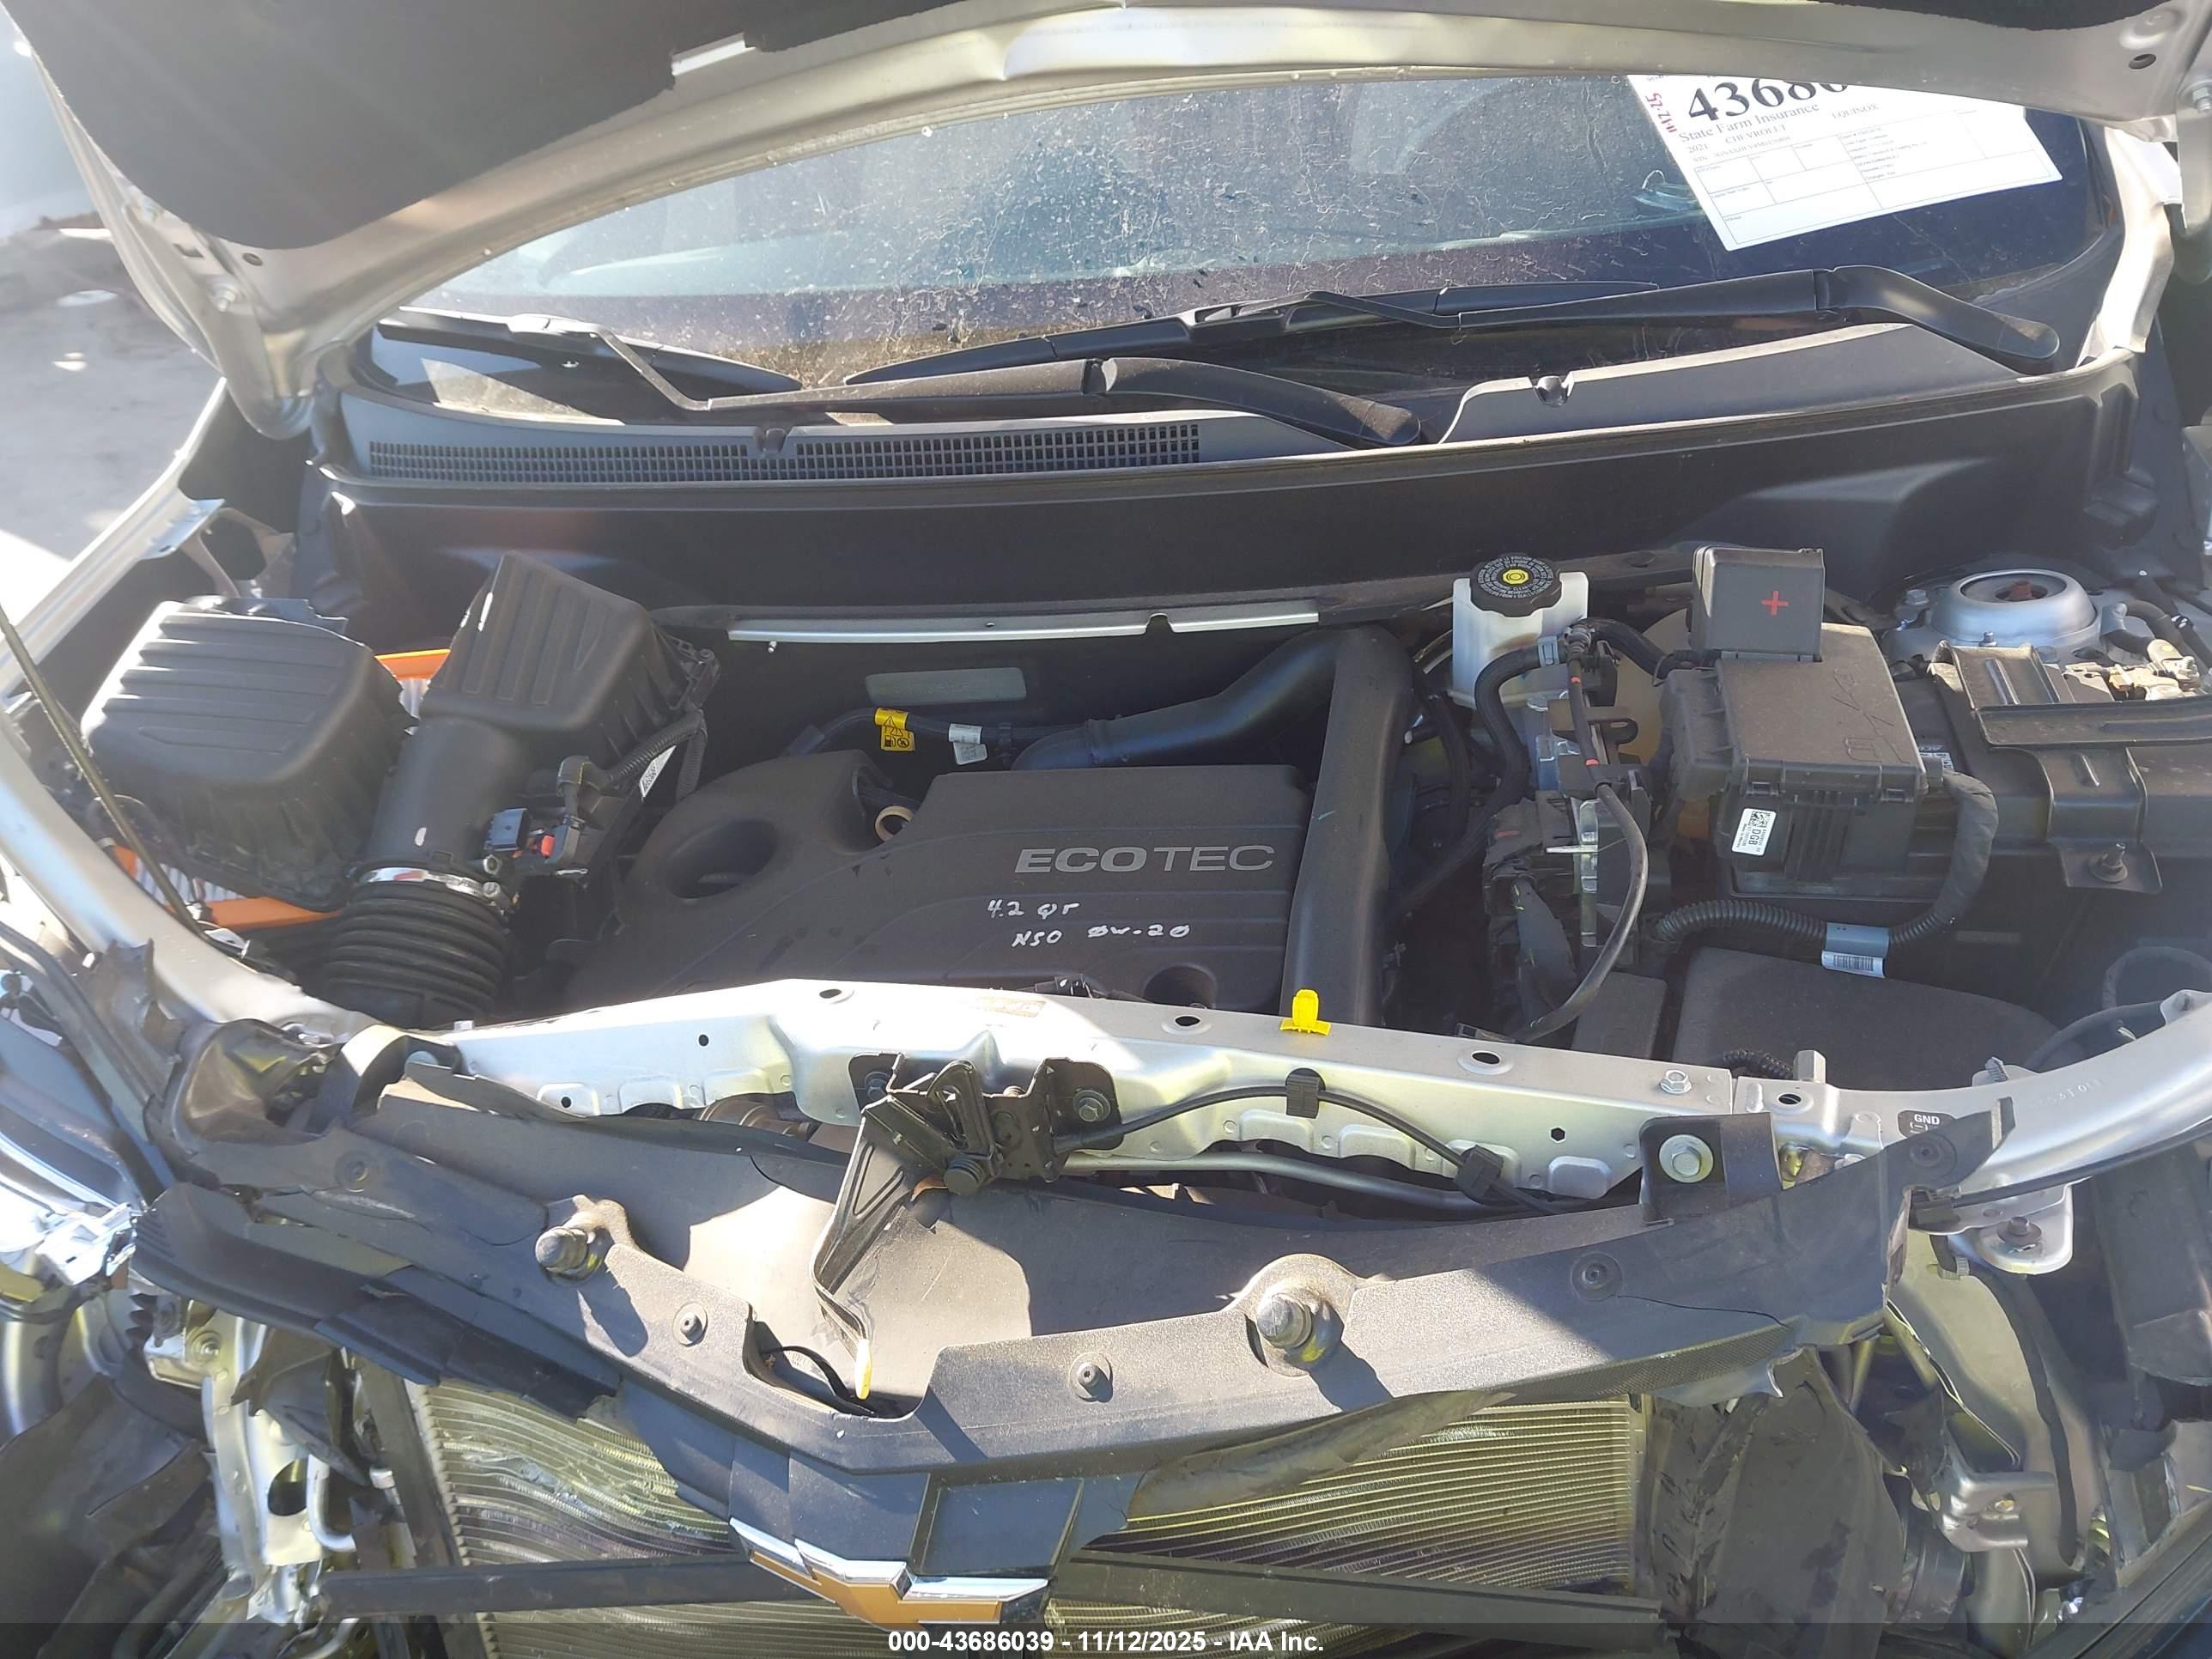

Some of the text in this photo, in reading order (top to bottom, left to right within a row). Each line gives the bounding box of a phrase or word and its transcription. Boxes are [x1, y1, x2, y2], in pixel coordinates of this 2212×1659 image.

[1688, 78, 1848, 120] 4368
[1679, 103, 1820, 143] State Farm Insurance
[1014, 845, 1275, 873] ECOTEC
[988, 899, 1024, 918] 4.2
[1914, 1114, 1940, 1125] GND
